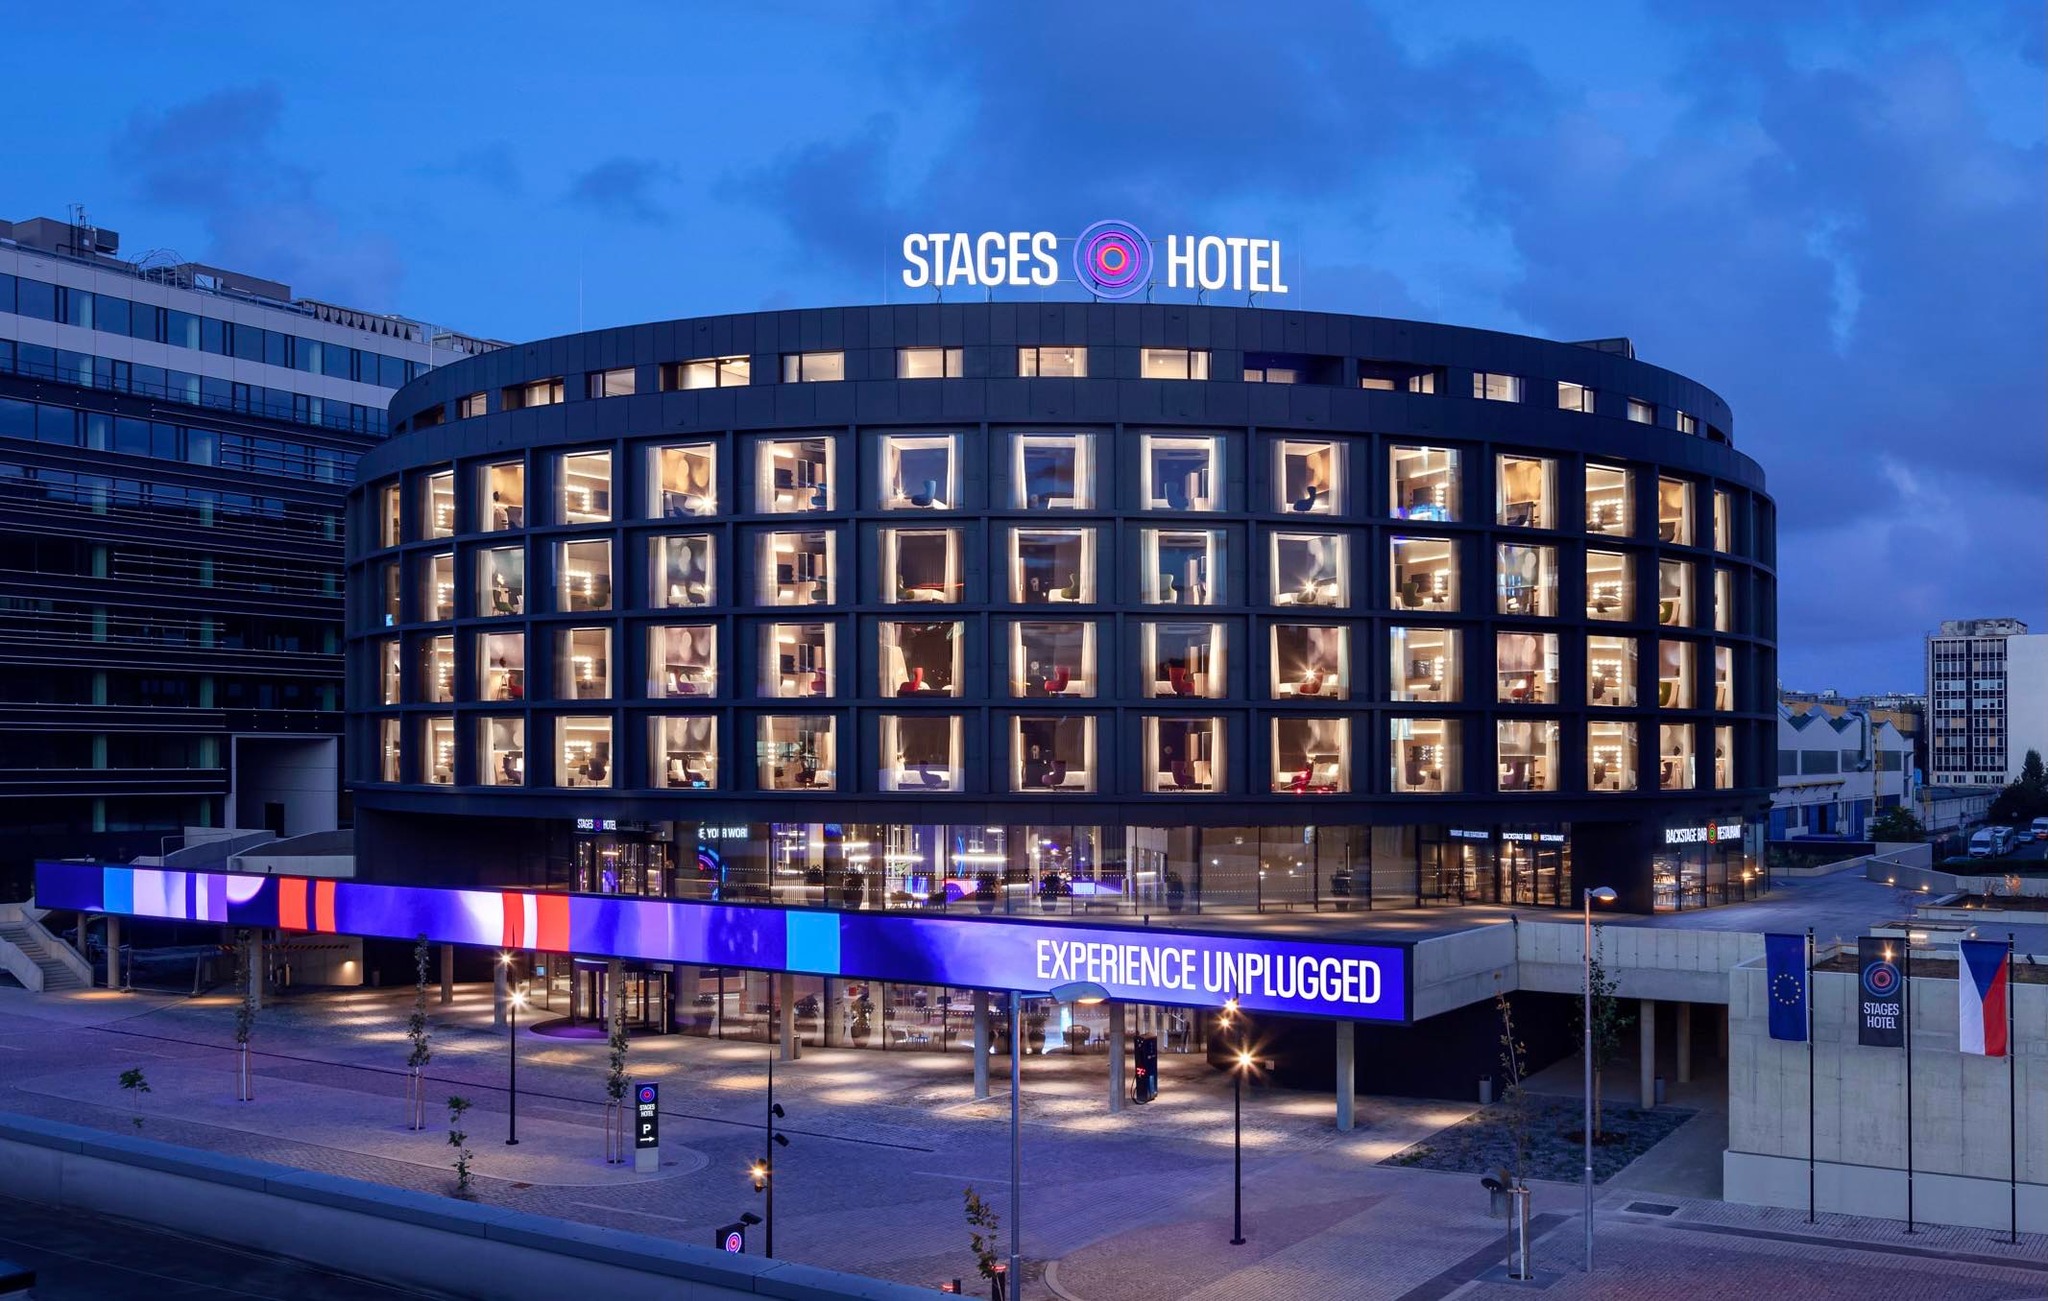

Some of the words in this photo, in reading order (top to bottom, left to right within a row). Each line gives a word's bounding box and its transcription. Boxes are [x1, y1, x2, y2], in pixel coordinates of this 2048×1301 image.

[902, 231, 1058, 287] STAGES
[1167, 234, 1288, 293] HOTEL
[577, 818, 593, 829] STAGES
[602, 819, 616, 830] HOTEL
[1665, 828, 1697, 843] BACKSTAGE
[1697, 827, 1707, 841] BAR
[1717, 825, 1741, 840] RESTAURANT
[1036, 939, 1196, 991] EXPERIENCE
[1203, 951, 1382, 1005] UNPLUGGED
[1863, 1002, 1899, 1016] STAGES
[1867, 1016, 1897, 1029] HOTEL
[639, 1103, 656, 1111] STAGES
[640, 1110, 654, 1118] HOTEL
[642, 1123, 652, 1135] P
